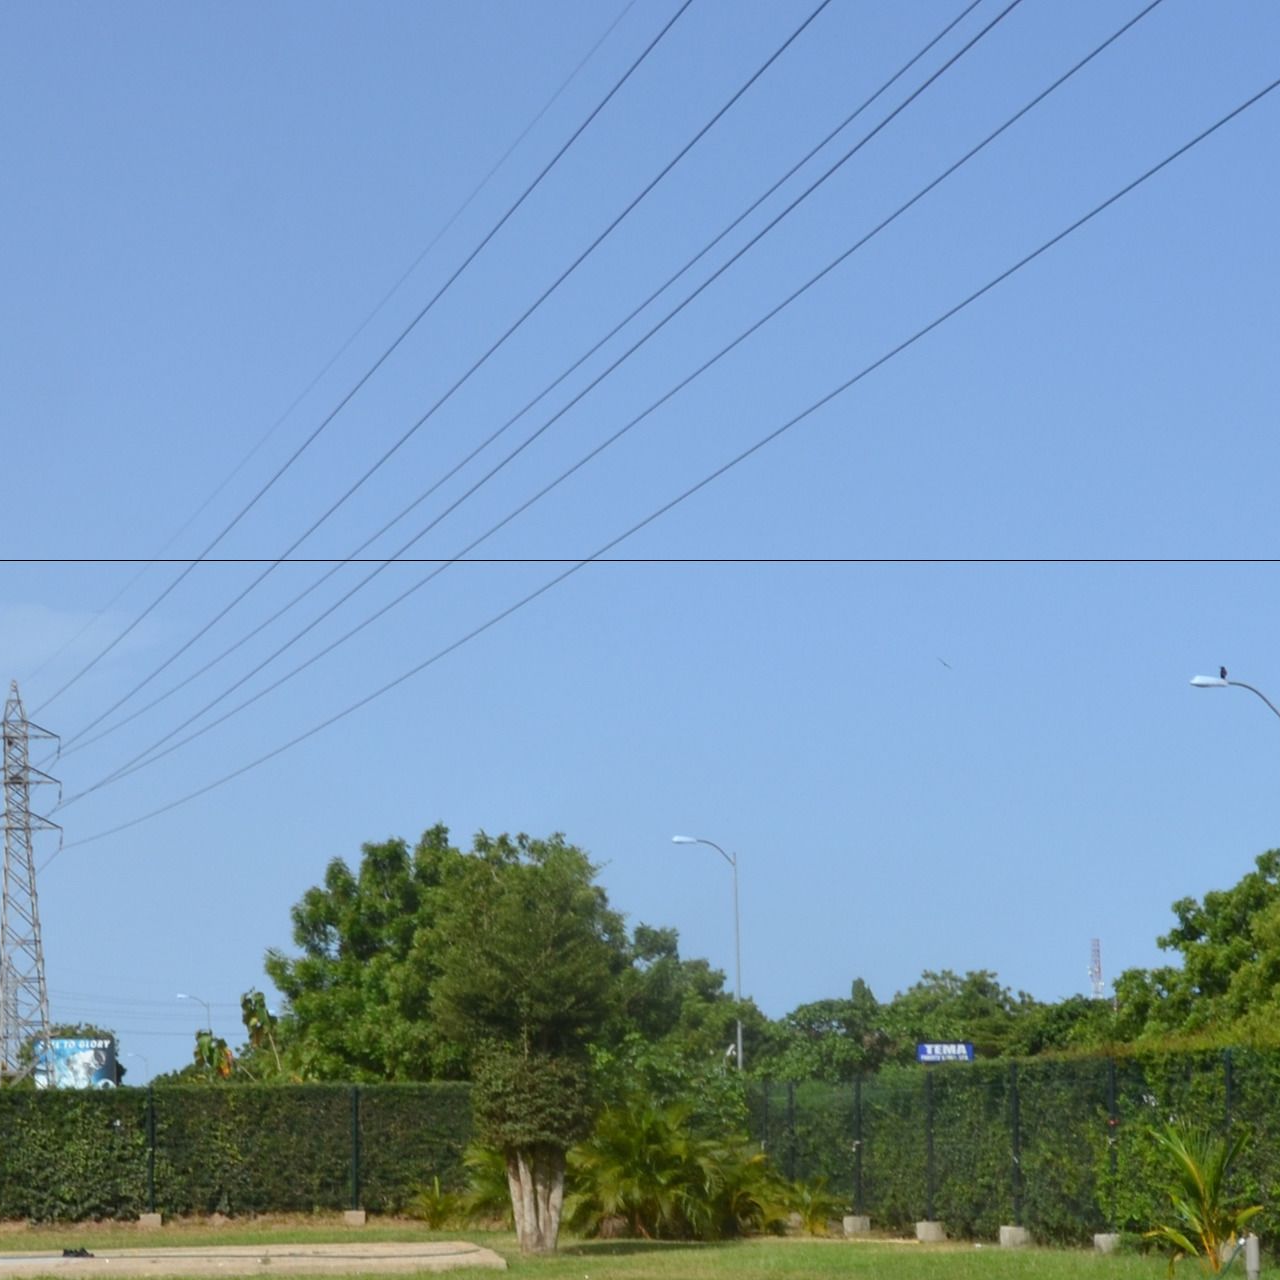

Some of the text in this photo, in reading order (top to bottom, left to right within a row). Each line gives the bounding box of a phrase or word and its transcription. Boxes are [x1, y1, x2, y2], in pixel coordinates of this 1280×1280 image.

[63, 1039, 75, 1049] TO
[78, 1039, 110, 1049] GLORY
[924, 1043, 968, 1055] TEMA
